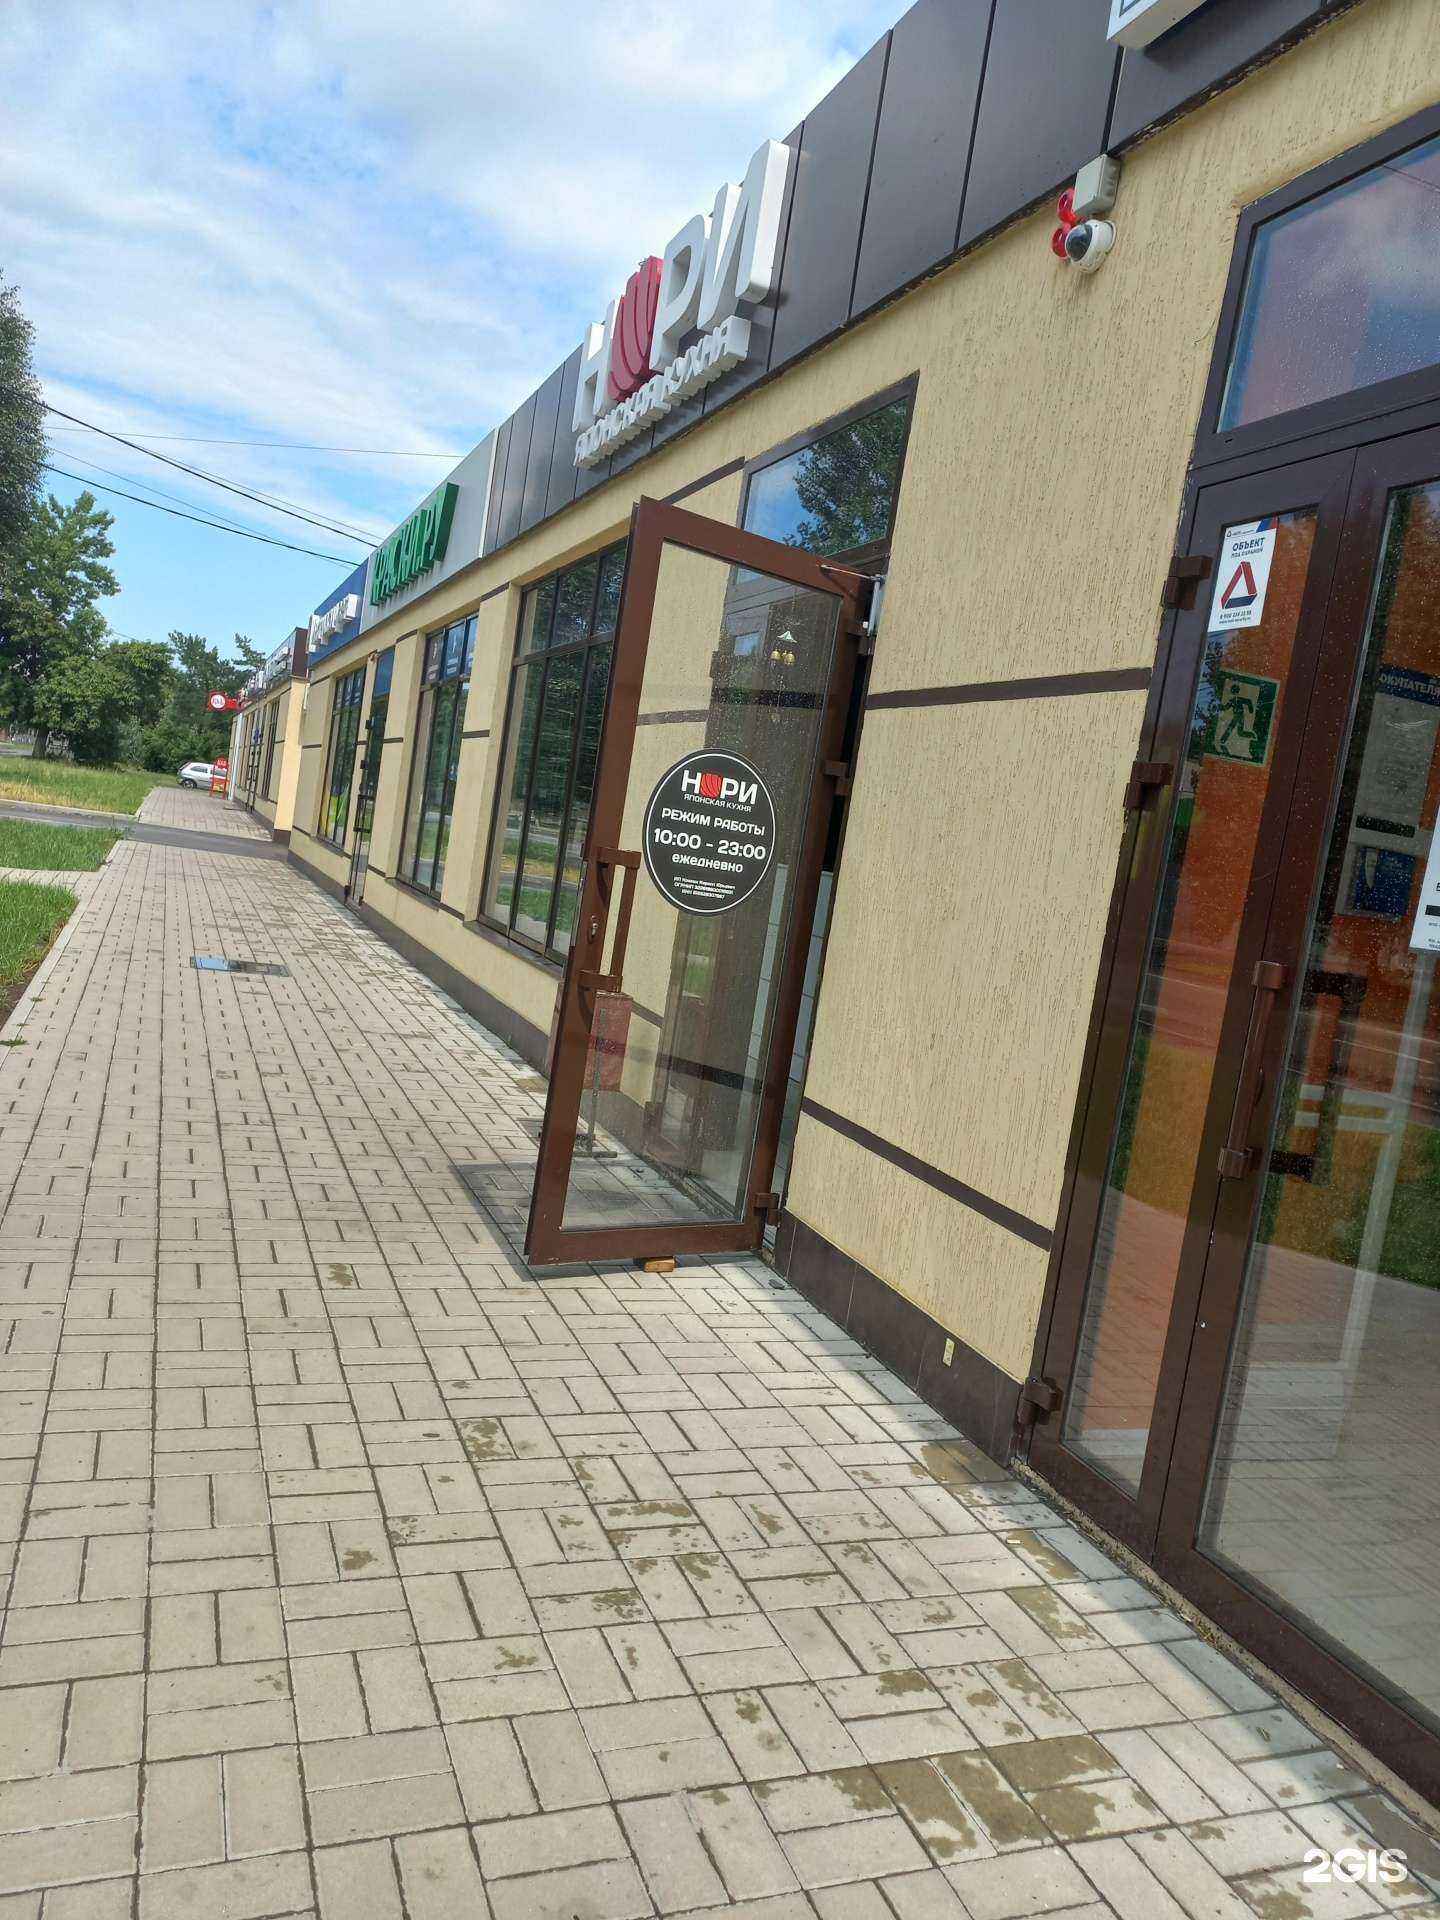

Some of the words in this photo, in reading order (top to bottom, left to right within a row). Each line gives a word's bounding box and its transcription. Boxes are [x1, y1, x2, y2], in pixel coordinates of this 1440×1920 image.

[572, 139, 790, 432] НОРИ
[1232, 537, 1265, 552] ОБЪЕКТ
[681, 769, 758, 805] НОРИ
[684, 793, 726, 808] ЯПОНСКАЯ
[726, 802, 752, 813] КУХНЯ
[661, 807, 711, 827] РЕЖИМ
[714, 817, 765, 836] РАБОТЫ
[654, 828, 701, 849] 10:00
[717, 839, 766, 860] 23:00
[672, 853, 744, 873] ежедневно
